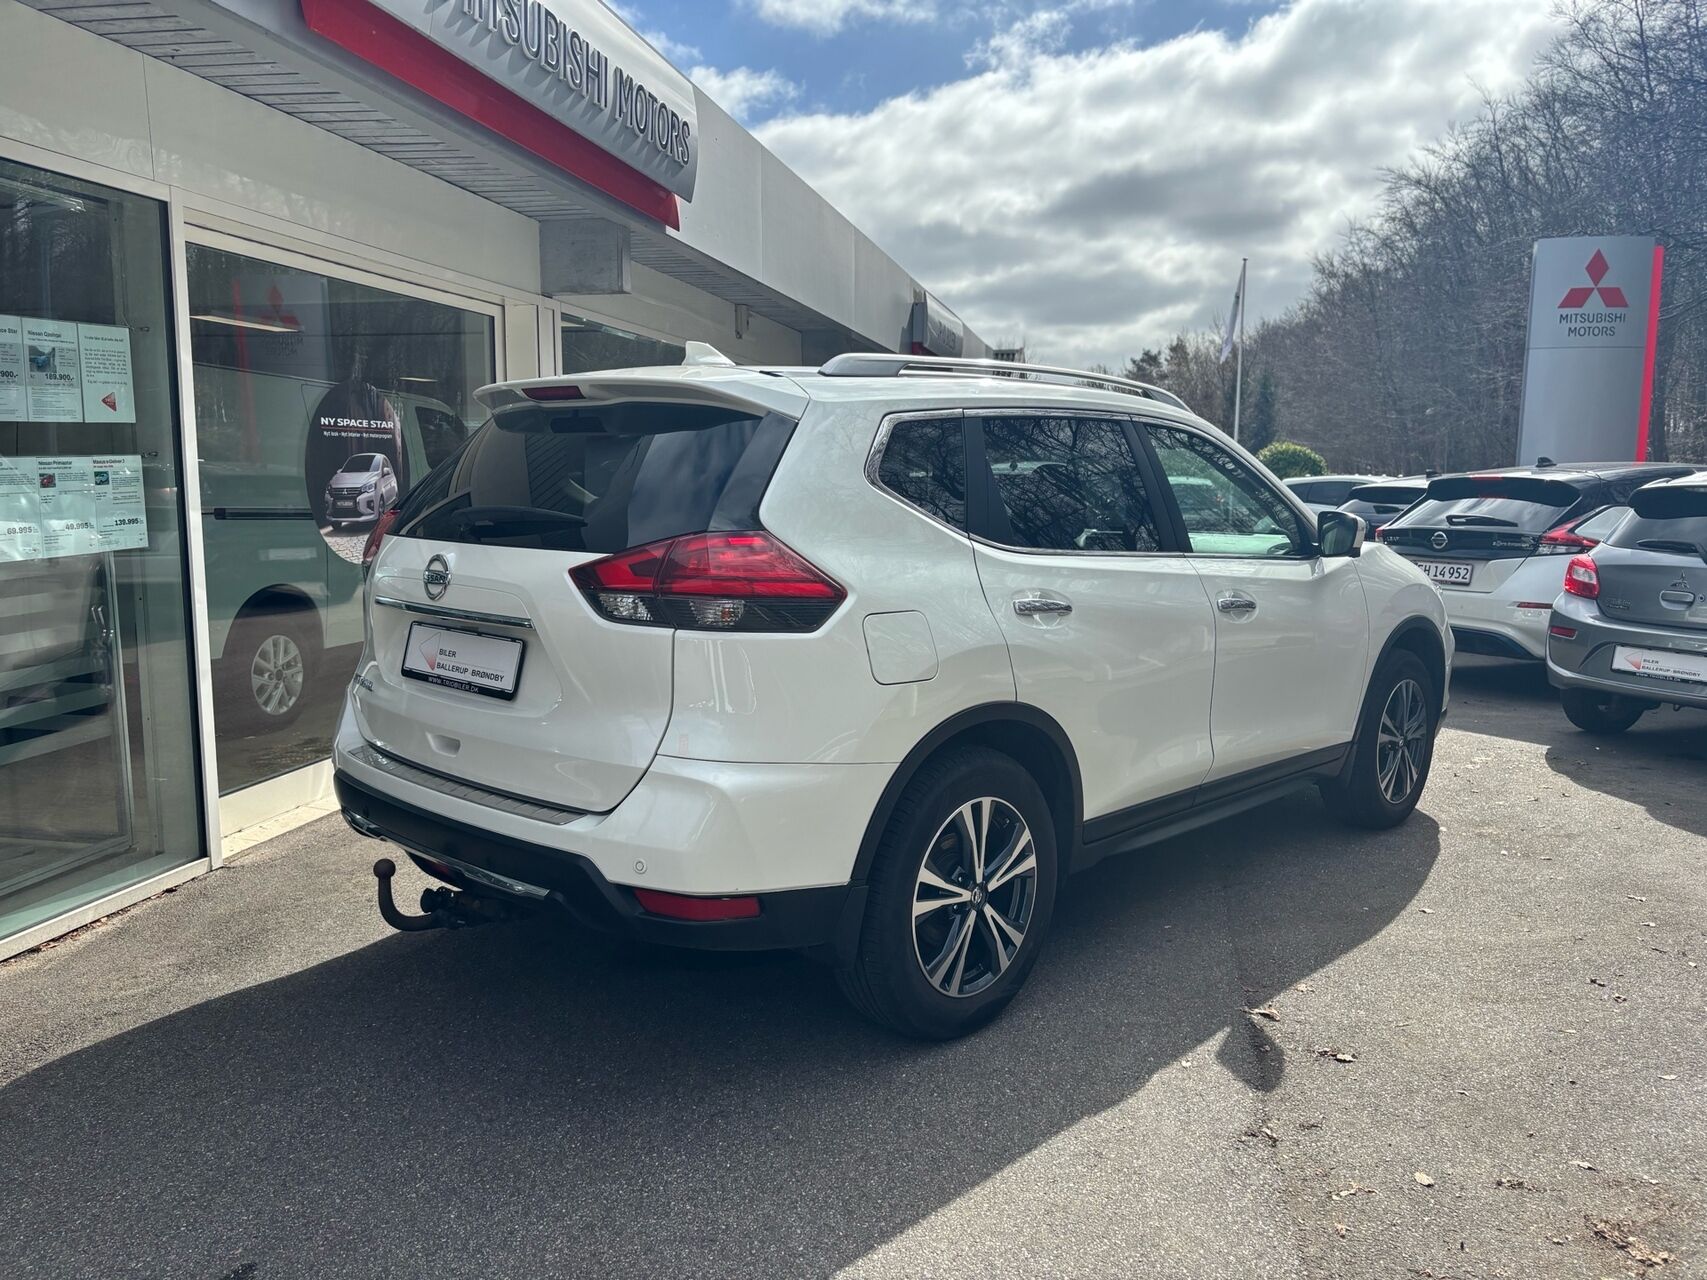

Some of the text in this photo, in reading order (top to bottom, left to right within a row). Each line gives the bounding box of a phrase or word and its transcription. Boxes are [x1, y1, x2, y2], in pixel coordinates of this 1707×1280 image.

[613, 66, 691, 167] MOTORS
[1559, 312, 1626, 324] MITSUBISHI
[1567, 325, 1616, 337] MOTORS
[320, 417, 394, 429] NY SPACE STAR
[1433, 566, 1446, 578] 14
[1448, 566, 1469, 580] 952
[439, 648, 457, 658] BILER
[436, 662, 505, 683] BALLERUP BRØNDBY
